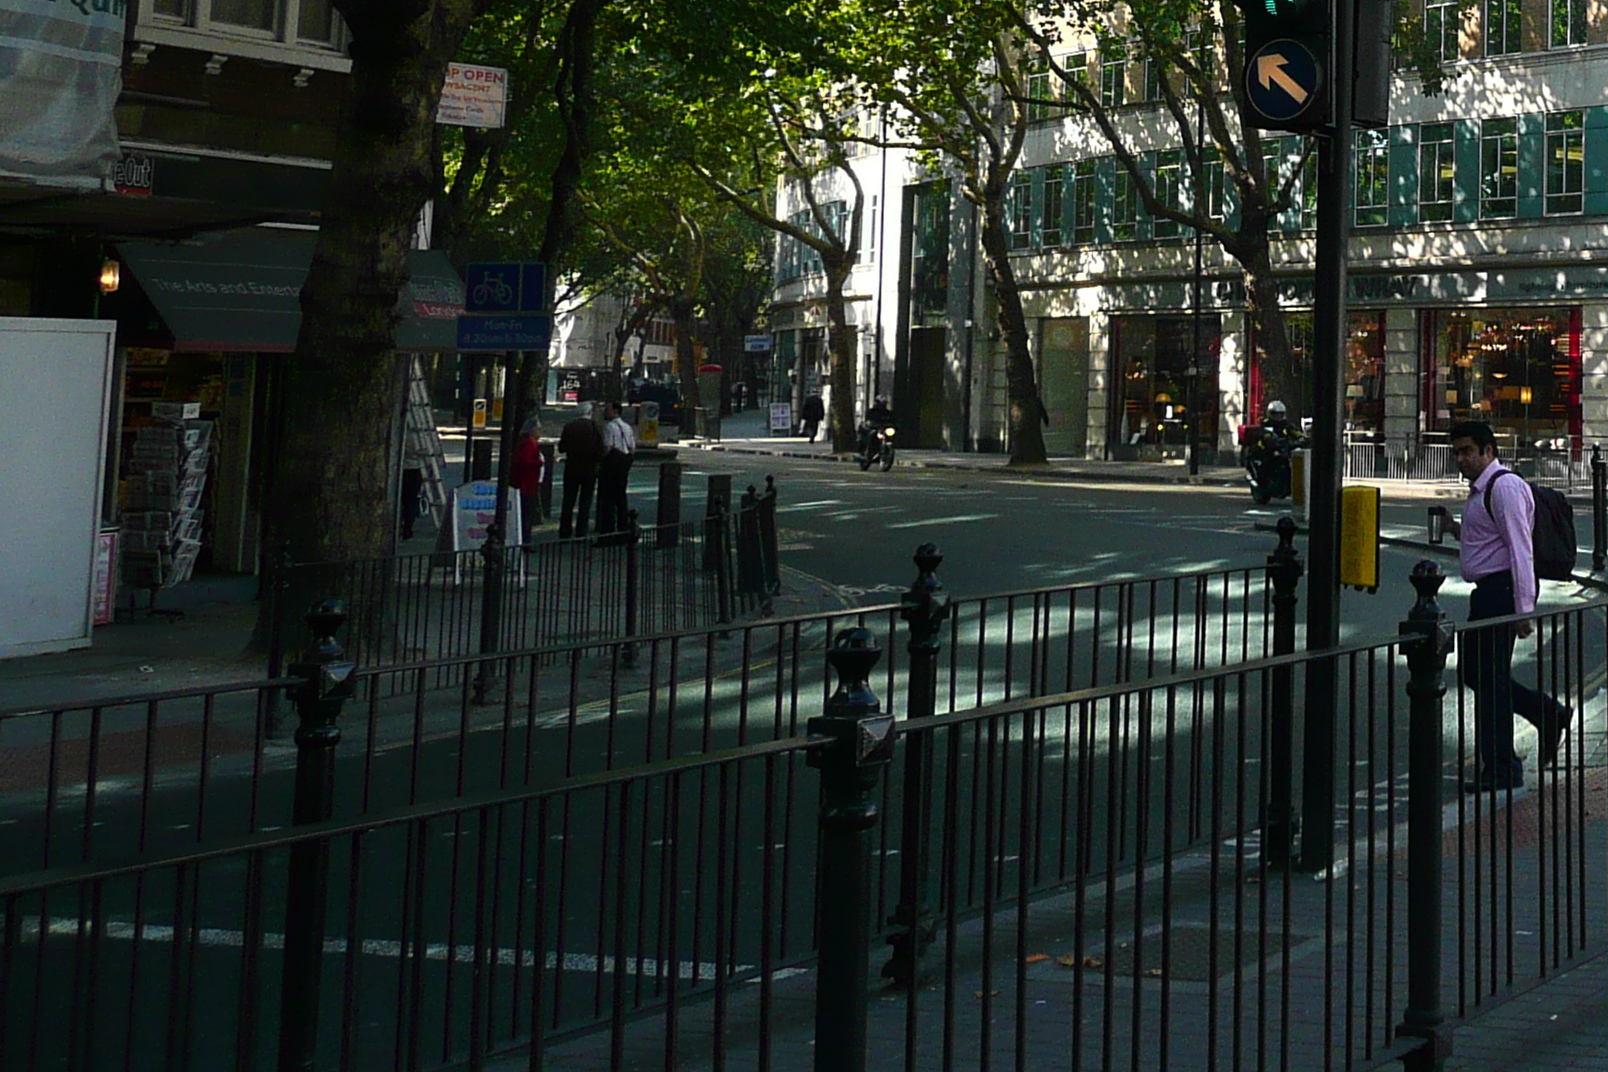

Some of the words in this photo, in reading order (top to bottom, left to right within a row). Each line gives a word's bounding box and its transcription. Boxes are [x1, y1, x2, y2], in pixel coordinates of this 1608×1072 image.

[464, 70, 504, 84] OPEN
[125, 157, 151, 188] Out
[151, 278, 184, 294] The
[185, 279, 217, 295] Arts
[218, 282, 247, 295] and
